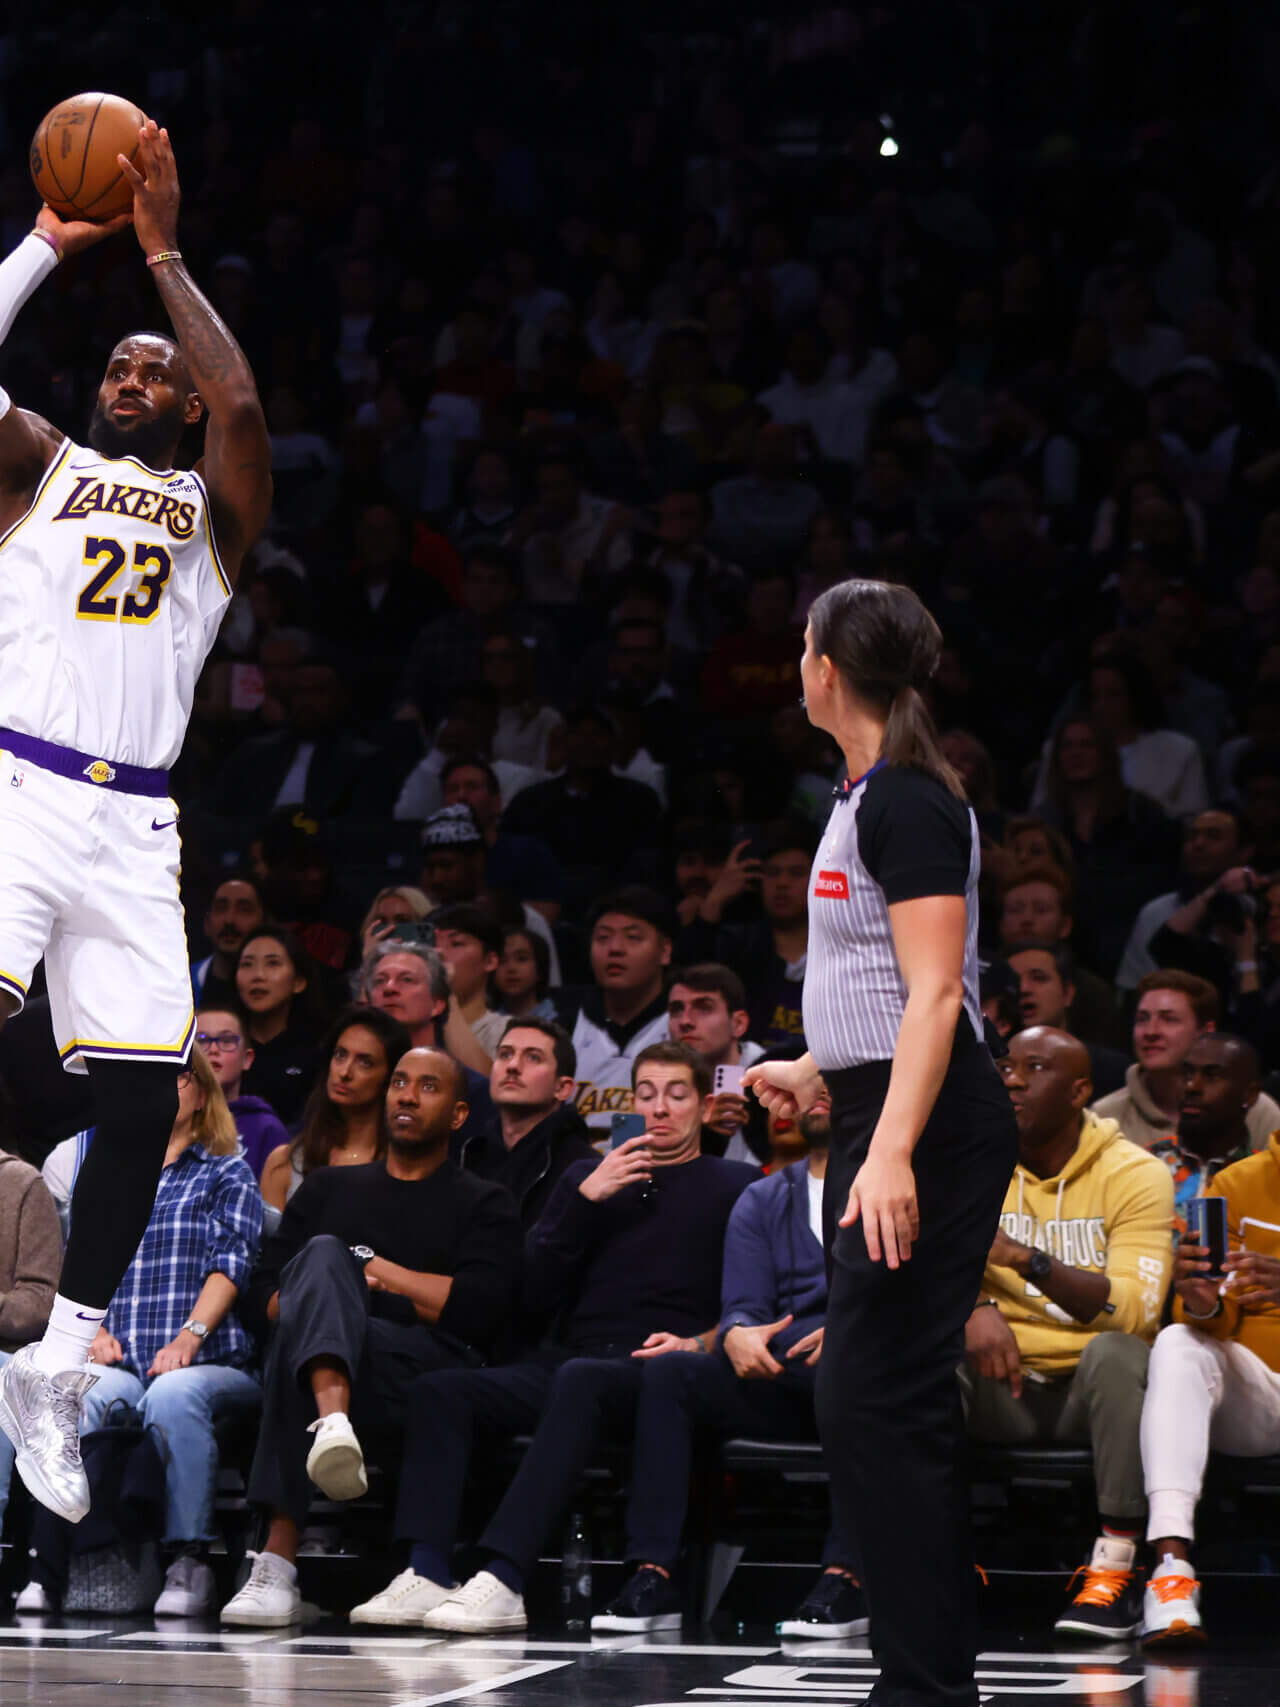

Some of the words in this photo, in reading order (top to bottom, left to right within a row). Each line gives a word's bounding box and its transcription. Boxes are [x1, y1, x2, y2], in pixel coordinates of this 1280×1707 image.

[51, 476, 197, 540] LAKERS
[76, 536, 172, 626] 23
[575, 1081, 634, 1115] LAKE
